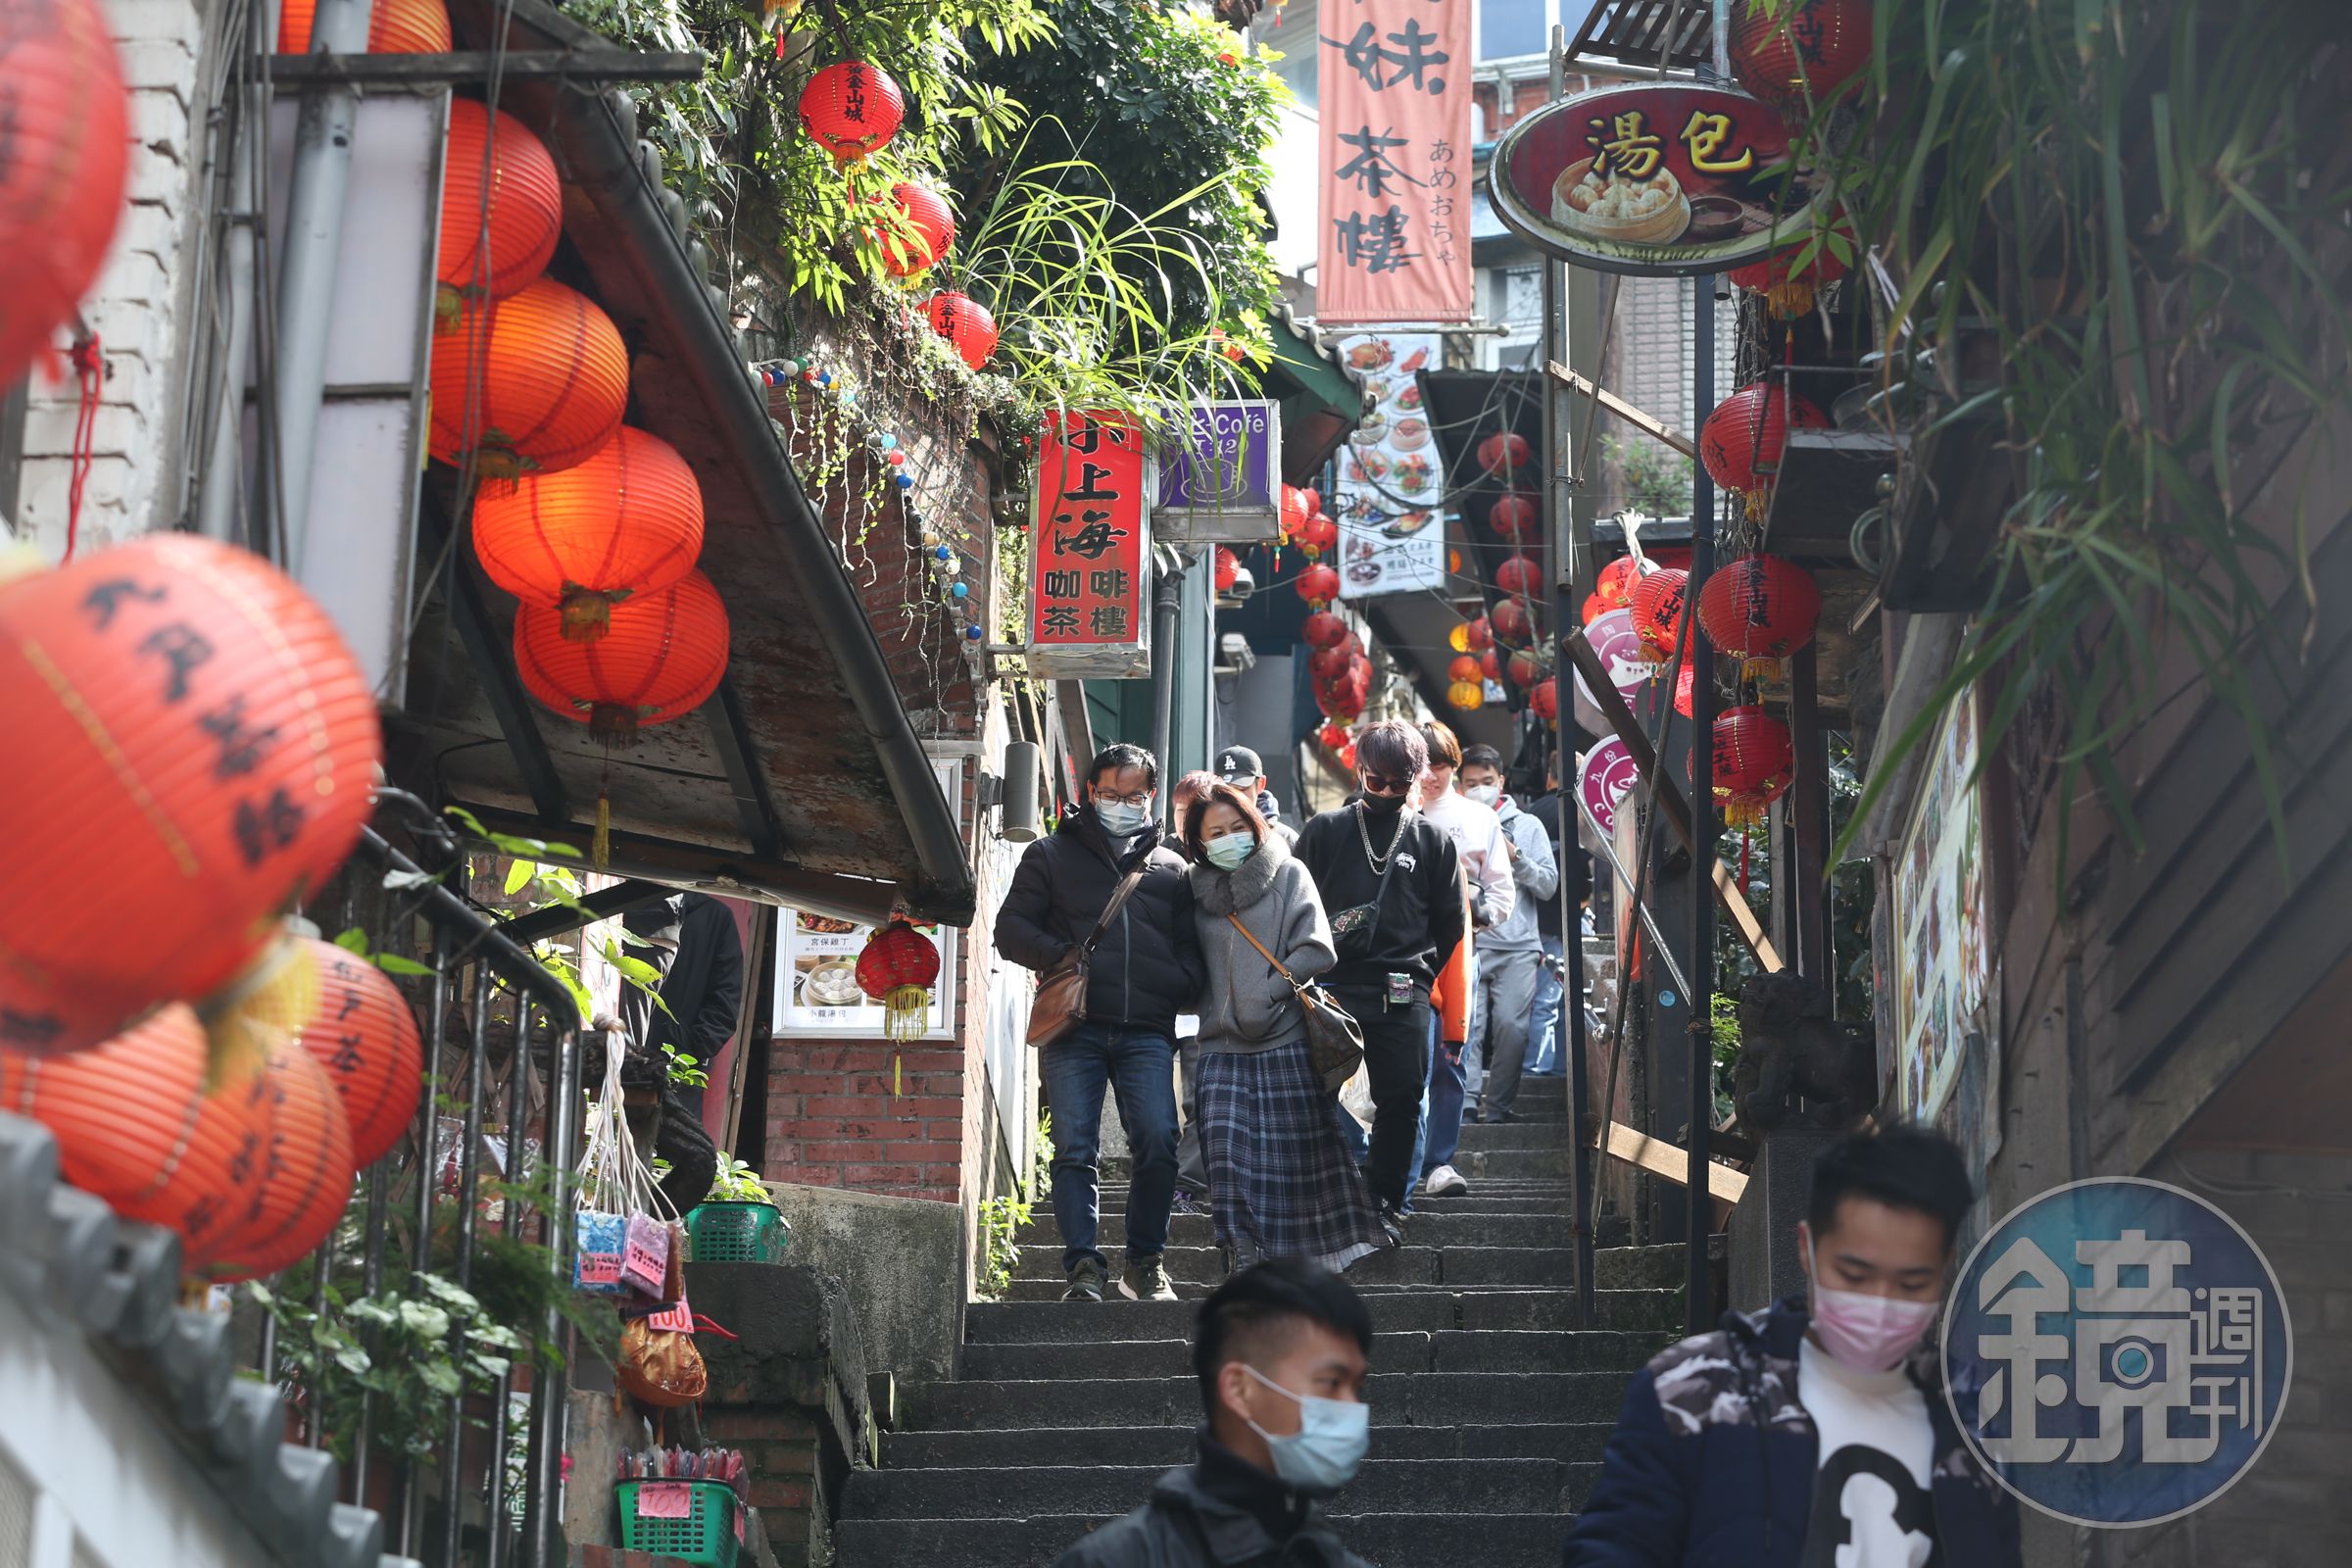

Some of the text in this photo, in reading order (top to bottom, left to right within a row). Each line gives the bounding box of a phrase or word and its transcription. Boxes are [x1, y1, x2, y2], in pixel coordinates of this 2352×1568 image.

[1320, 0, 1450, 274] 妹茶樓
[1587, 111, 1753, 178] 湯包
[1429, 139, 1457, 267] あめおちゃ
[1045, 569, 1129, 600] 咖啡
[1042, 607, 1128, 637] 茶樓
[1224, 755, 1237, 770] LA
